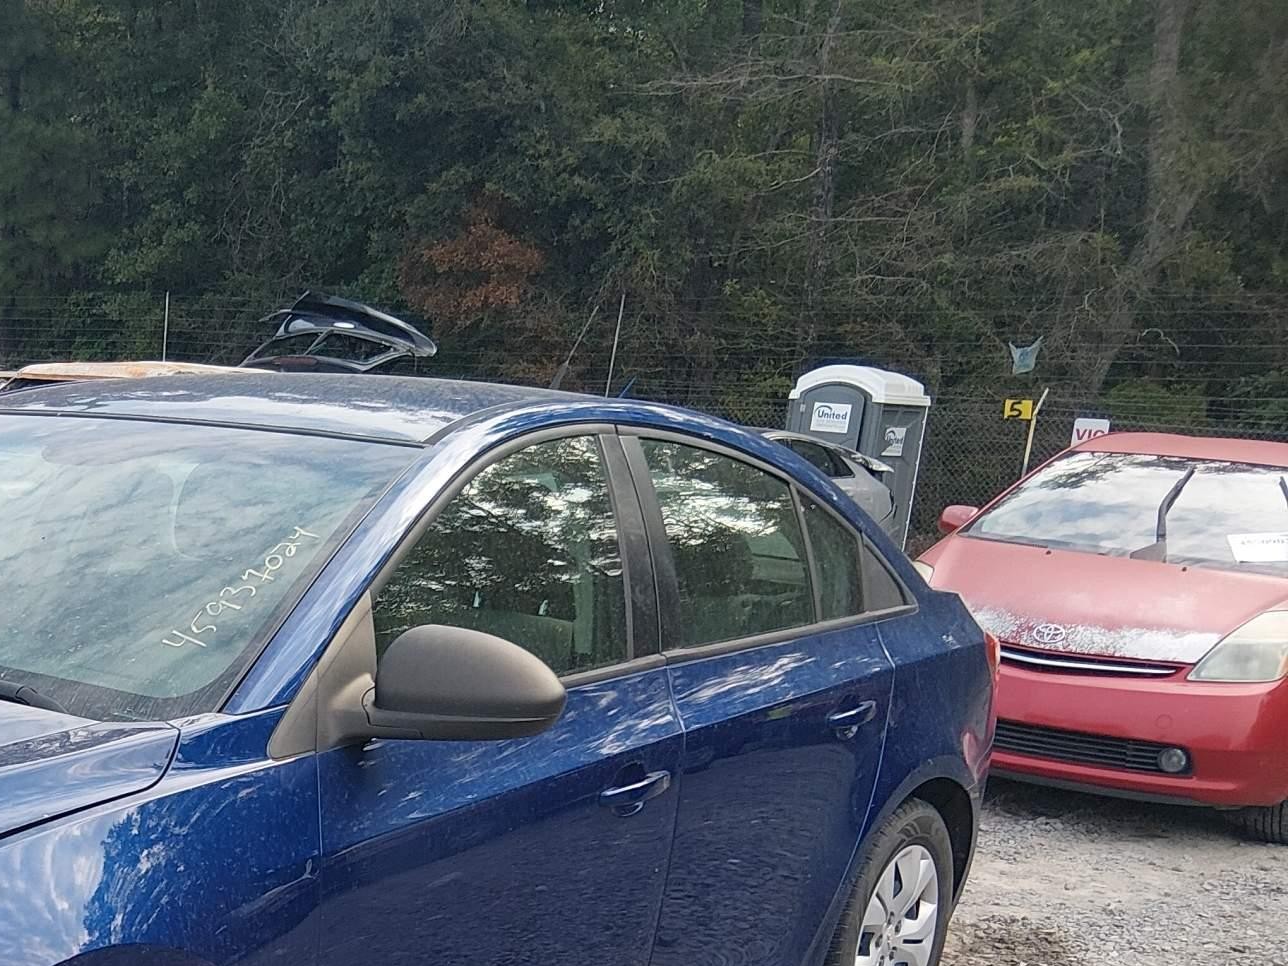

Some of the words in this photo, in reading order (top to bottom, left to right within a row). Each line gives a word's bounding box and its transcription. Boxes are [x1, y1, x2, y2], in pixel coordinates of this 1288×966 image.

[817, 409, 848, 421] United
[1007, 400, 1023, 418] 5
[161, 525, 320, 649] 45937024
